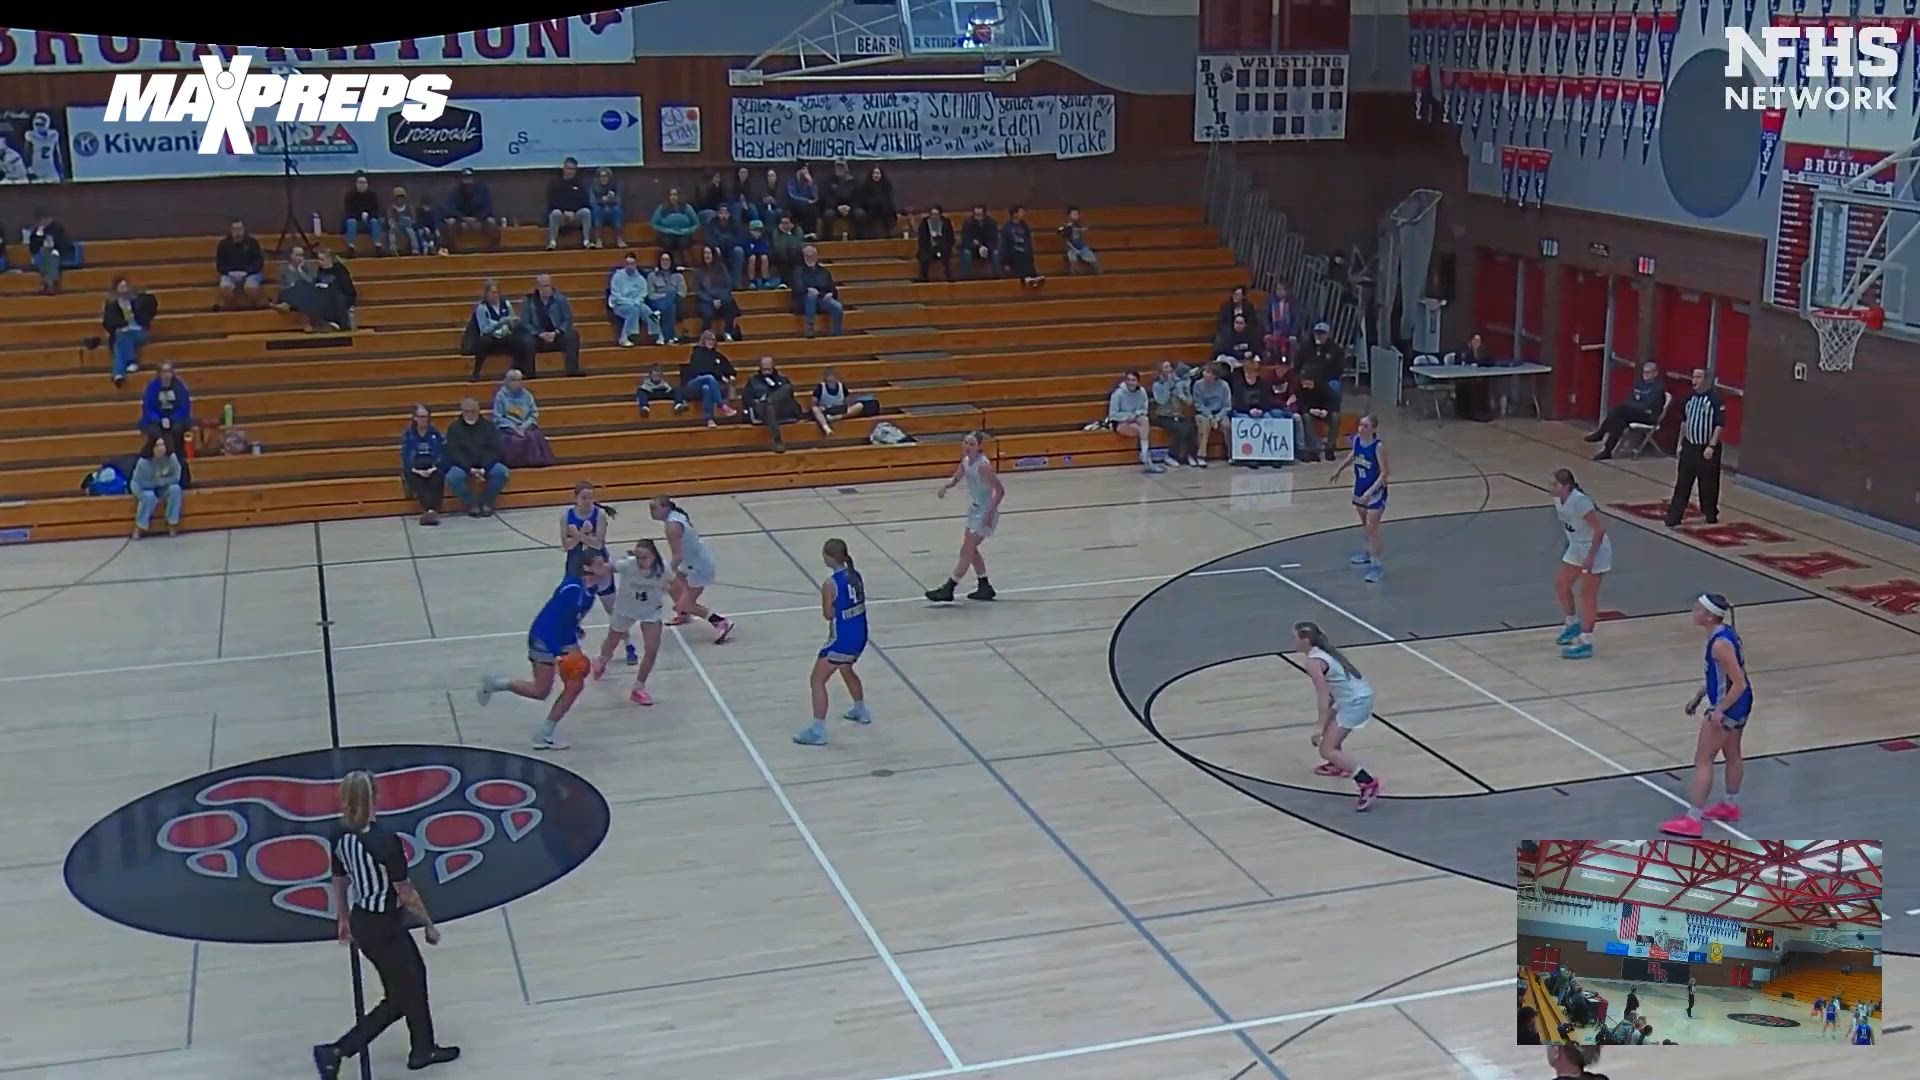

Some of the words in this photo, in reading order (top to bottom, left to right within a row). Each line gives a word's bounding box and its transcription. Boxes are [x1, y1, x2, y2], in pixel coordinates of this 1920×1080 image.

[857, 36, 887, 53] BEAR
[1240, 57, 1342, 68] WRESTLING
[1200, 59, 1230, 138] BRUINS
[800, 114, 855, 133] Brooke
[999, 114, 1041, 137] Eden
[105, 131, 201, 153] Kiwani
[734, 138, 794, 159] Hayden
[1237, 419, 1262, 440] GO
